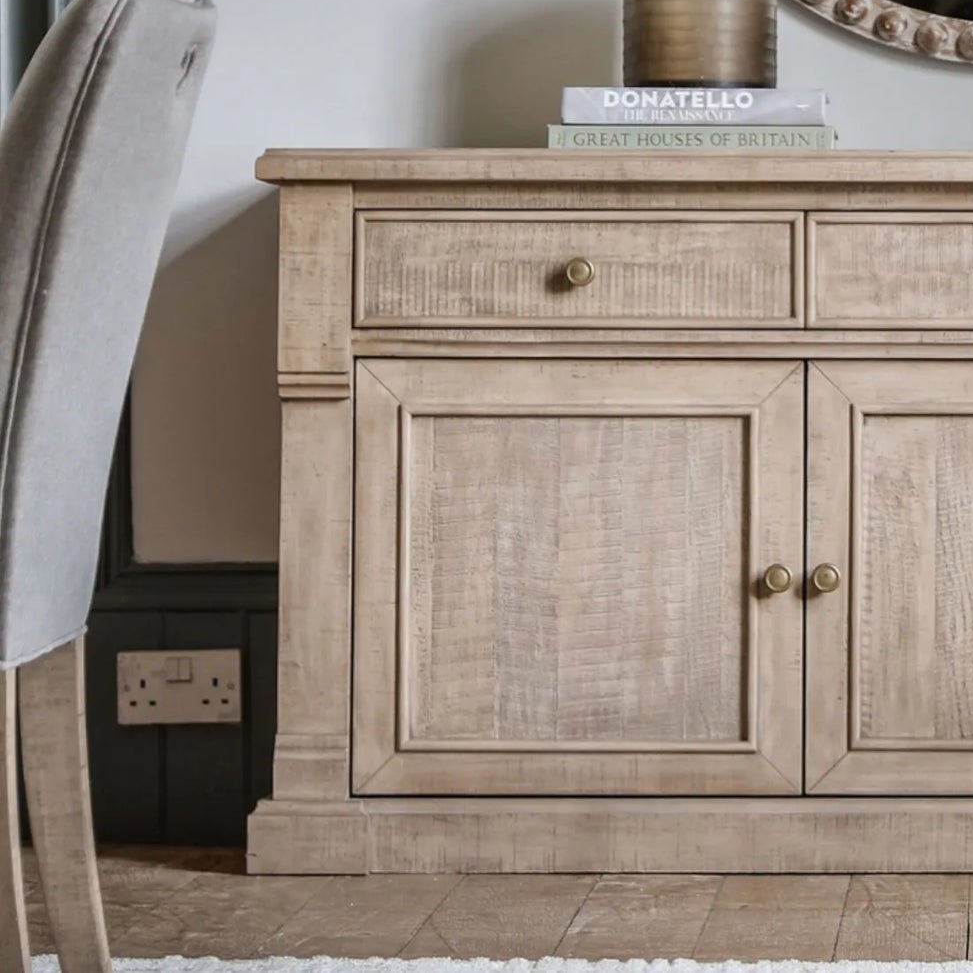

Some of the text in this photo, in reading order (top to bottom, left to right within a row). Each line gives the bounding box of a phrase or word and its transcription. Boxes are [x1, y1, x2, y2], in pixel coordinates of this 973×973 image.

[603, 90, 754, 109] DONATELLO
[651, 109, 737, 121] RENAISSANCE
[573, 132, 632, 147] GREAT
[637, 132, 703, 147] HOUSES
[710, 132, 731, 147] OF
[738, 132, 810, 147] BRITAIN
